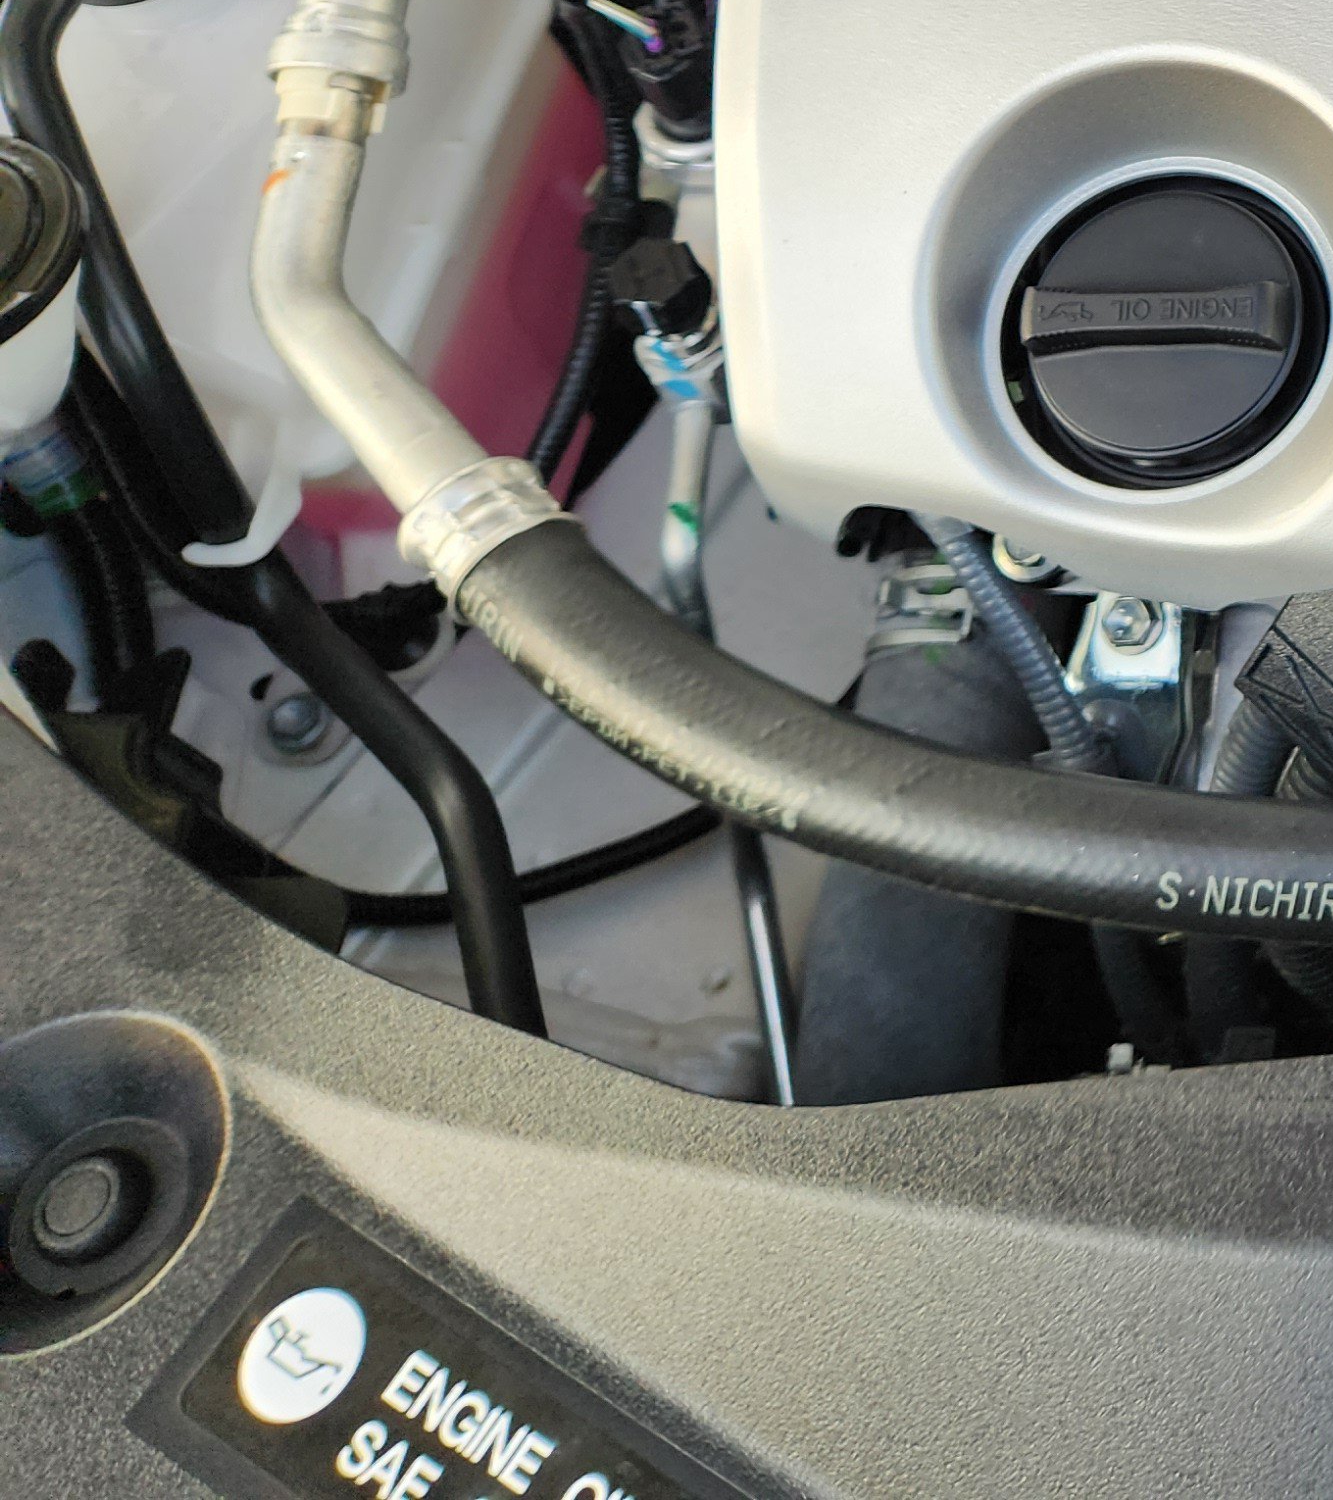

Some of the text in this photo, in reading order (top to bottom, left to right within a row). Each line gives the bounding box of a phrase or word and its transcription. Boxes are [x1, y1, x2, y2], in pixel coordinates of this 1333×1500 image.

[1111, 297, 1254, 322] ENGINE OIL
[335, 1419, 446, 1500] SAE
[380, 1348, 559, 1496] ENGINE
